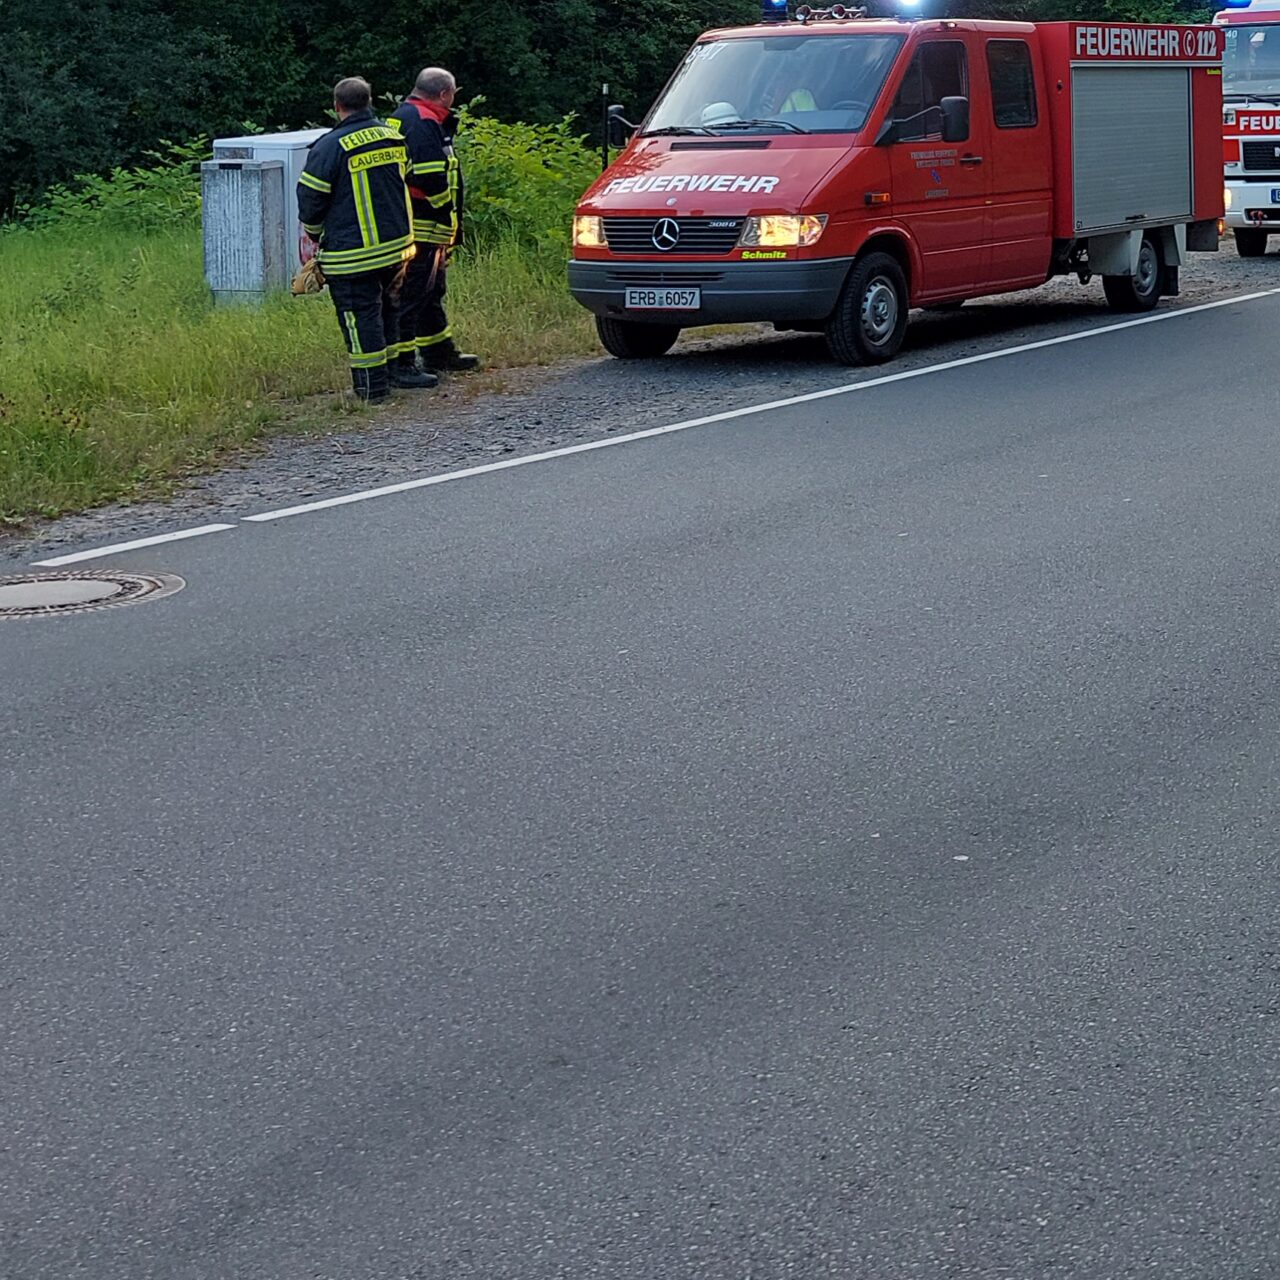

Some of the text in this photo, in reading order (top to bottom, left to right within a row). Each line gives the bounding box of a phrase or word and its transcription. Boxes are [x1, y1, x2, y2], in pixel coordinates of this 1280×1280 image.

[1076, 26, 1217, 57] FEUERWEHR 112
[350, 149, 404, 169] LAUERBACH
[602, 175, 780, 195] FEUERWEHR
[741, 251, 787, 260] Schmitz
[665, 291, 696, 306] 6057
